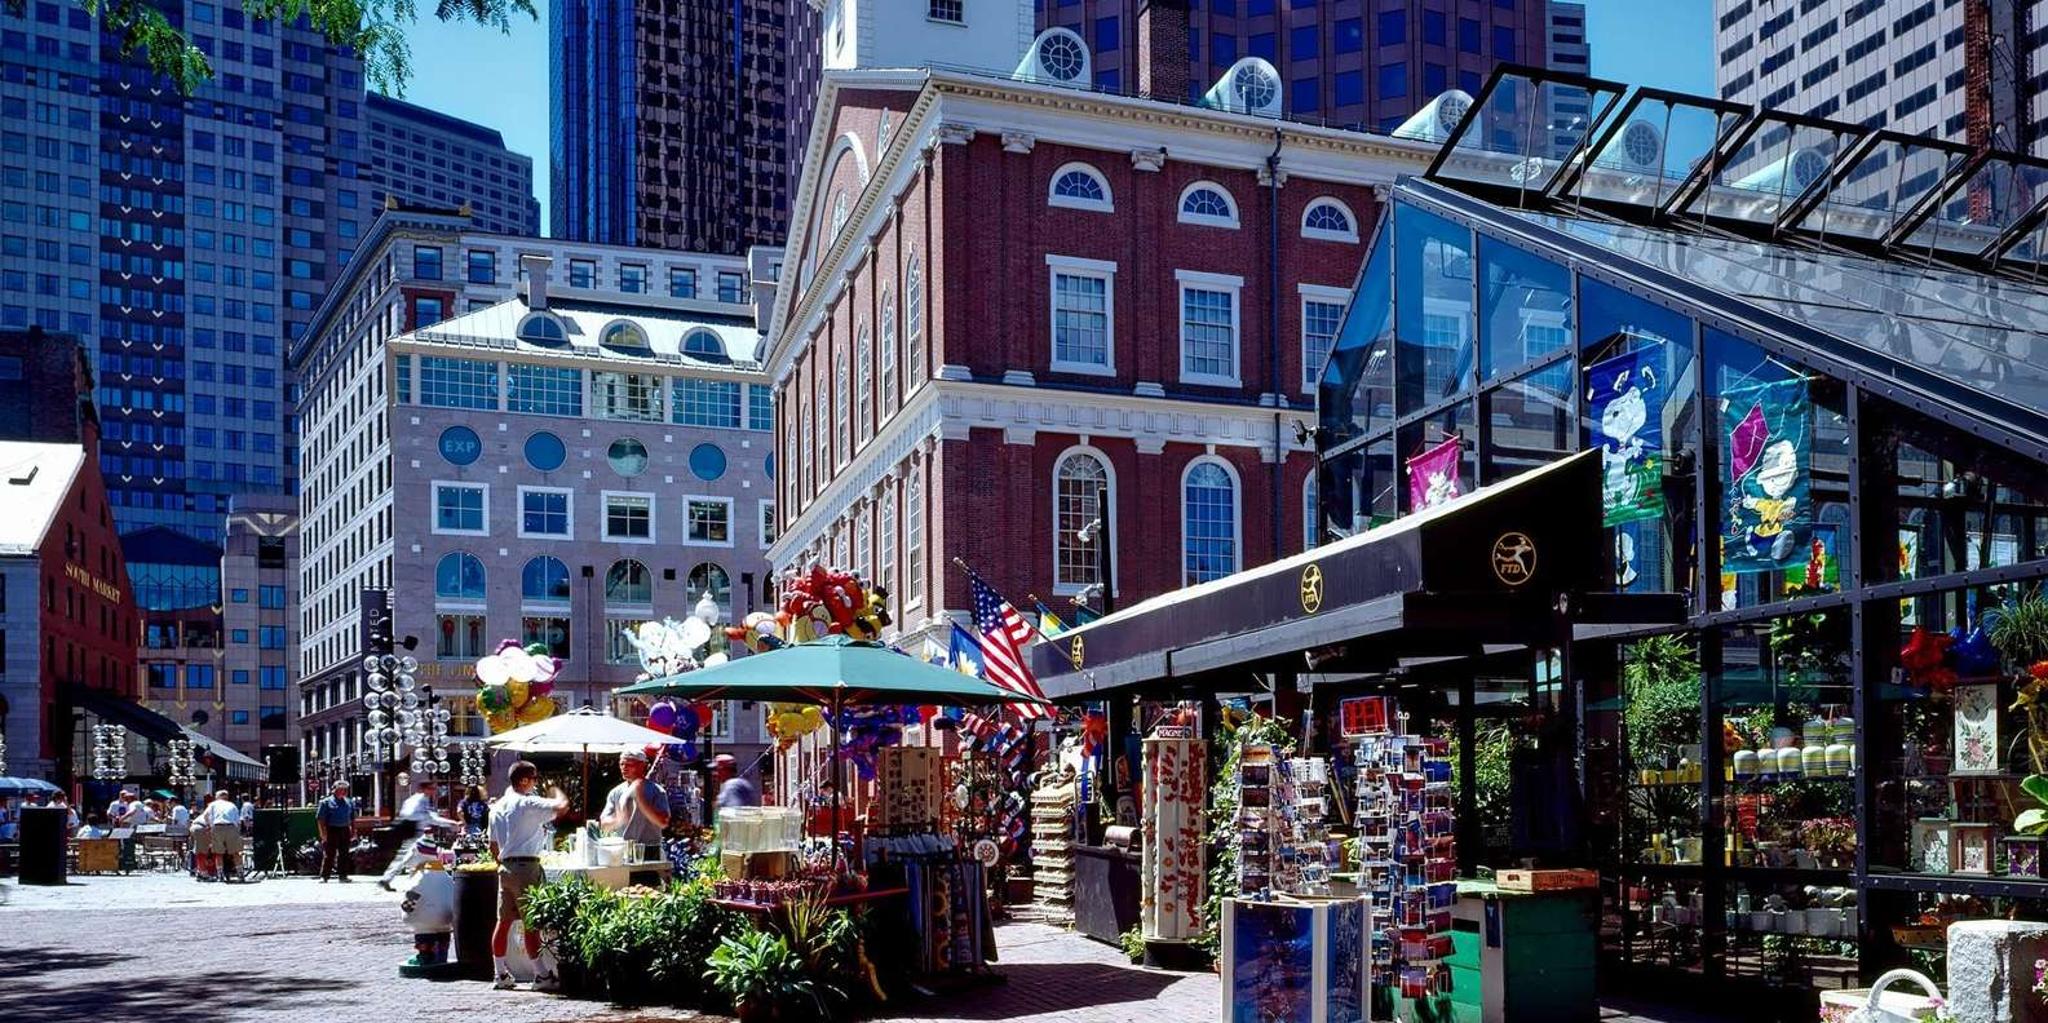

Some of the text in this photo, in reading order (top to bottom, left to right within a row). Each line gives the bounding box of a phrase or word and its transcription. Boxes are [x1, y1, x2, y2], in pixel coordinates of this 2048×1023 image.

[444, 440, 476, 453] EXP
[1500, 563, 1521, 574] FTD
[65, 561, 120, 605] SOUTH MARKET
